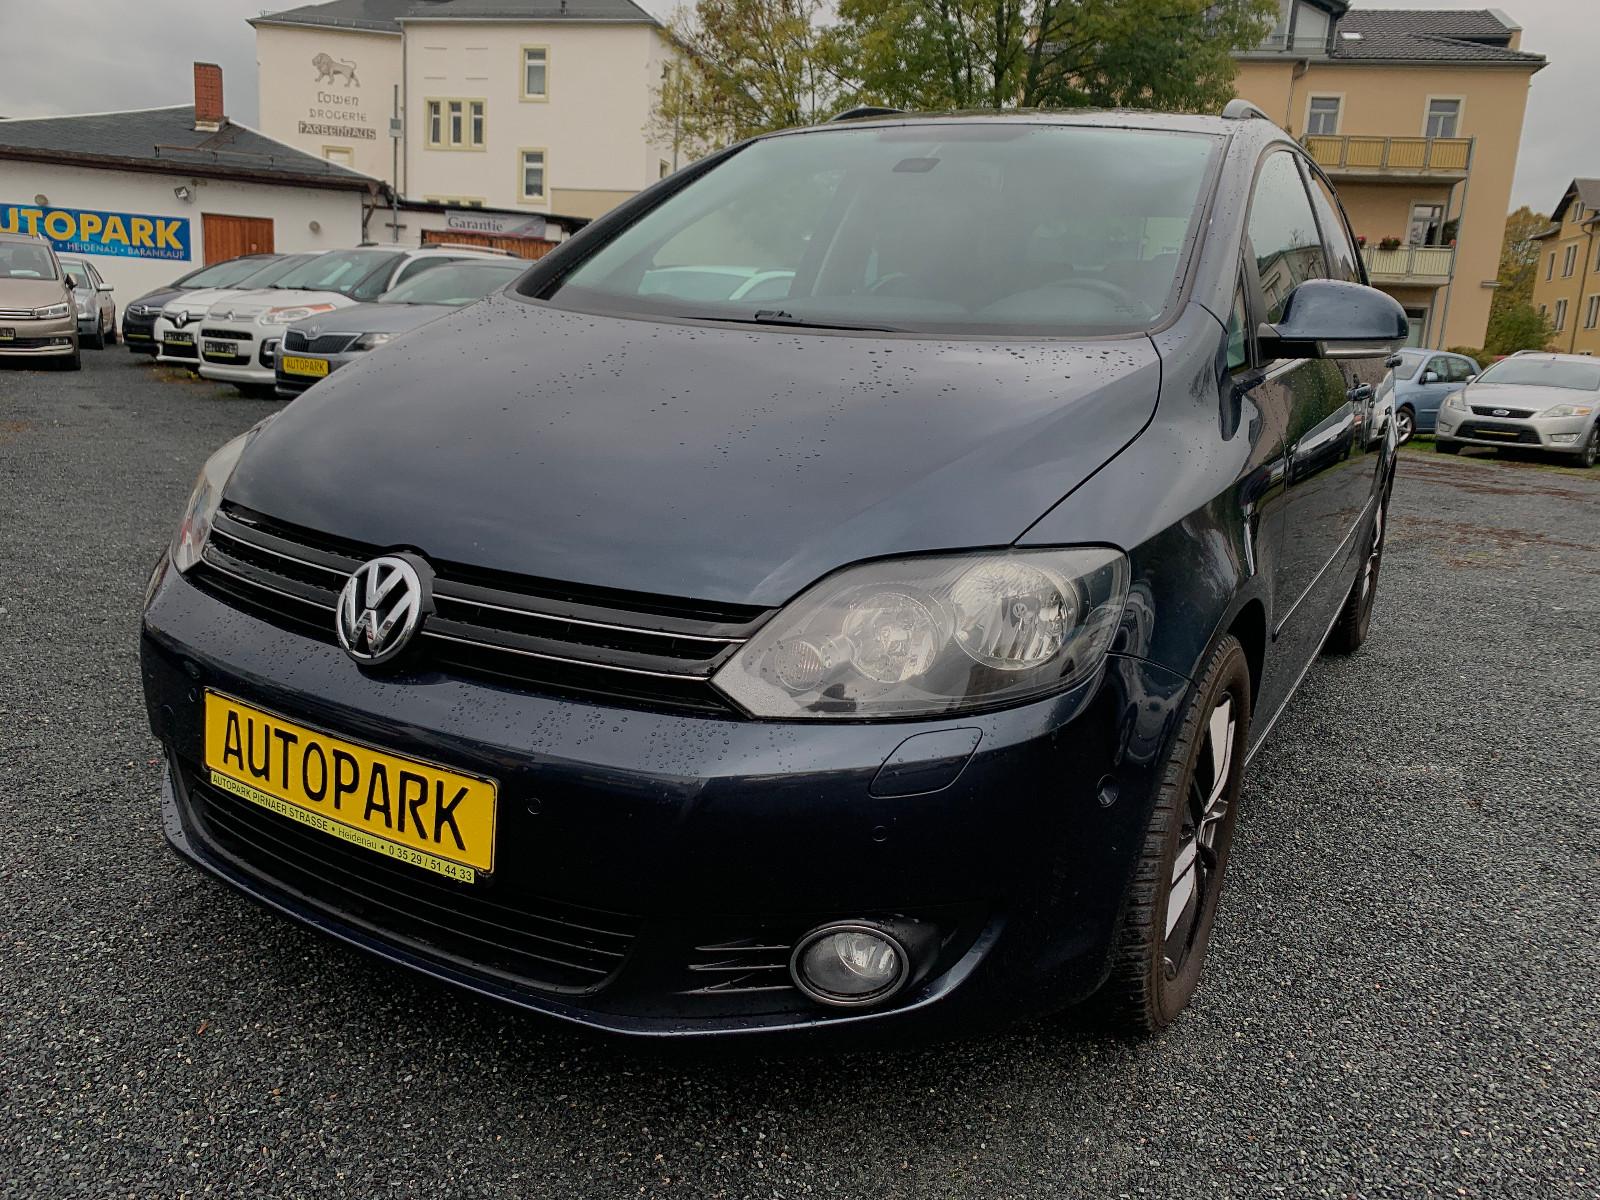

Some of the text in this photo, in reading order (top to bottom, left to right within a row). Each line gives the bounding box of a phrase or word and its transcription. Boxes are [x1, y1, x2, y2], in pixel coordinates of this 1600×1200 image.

[309, 108, 367, 122] DROGERIE
[448, 216, 503, 232] Garantie
[66, 242, 118, 254] HEIDENAU
[286, 359, 325, 372] AUTOPARK
[222, 709, 469, 851] AUTOPARK
[212, 774, 252, 799] AUTOPARK
[252, 792, 287, 815] PIRNAER
[289, 807, 328, 831] STRASSE
[338, 827, 377, 849] Heidenau
[388, 845, 394, 855] 0
[397, 848, 408, 860] 35
[411, 852, 422, 864] 29
[430, 860, 441, 871] 51
[445, 865, 456, 876] 44
[460, 868, 472, 881] 33
